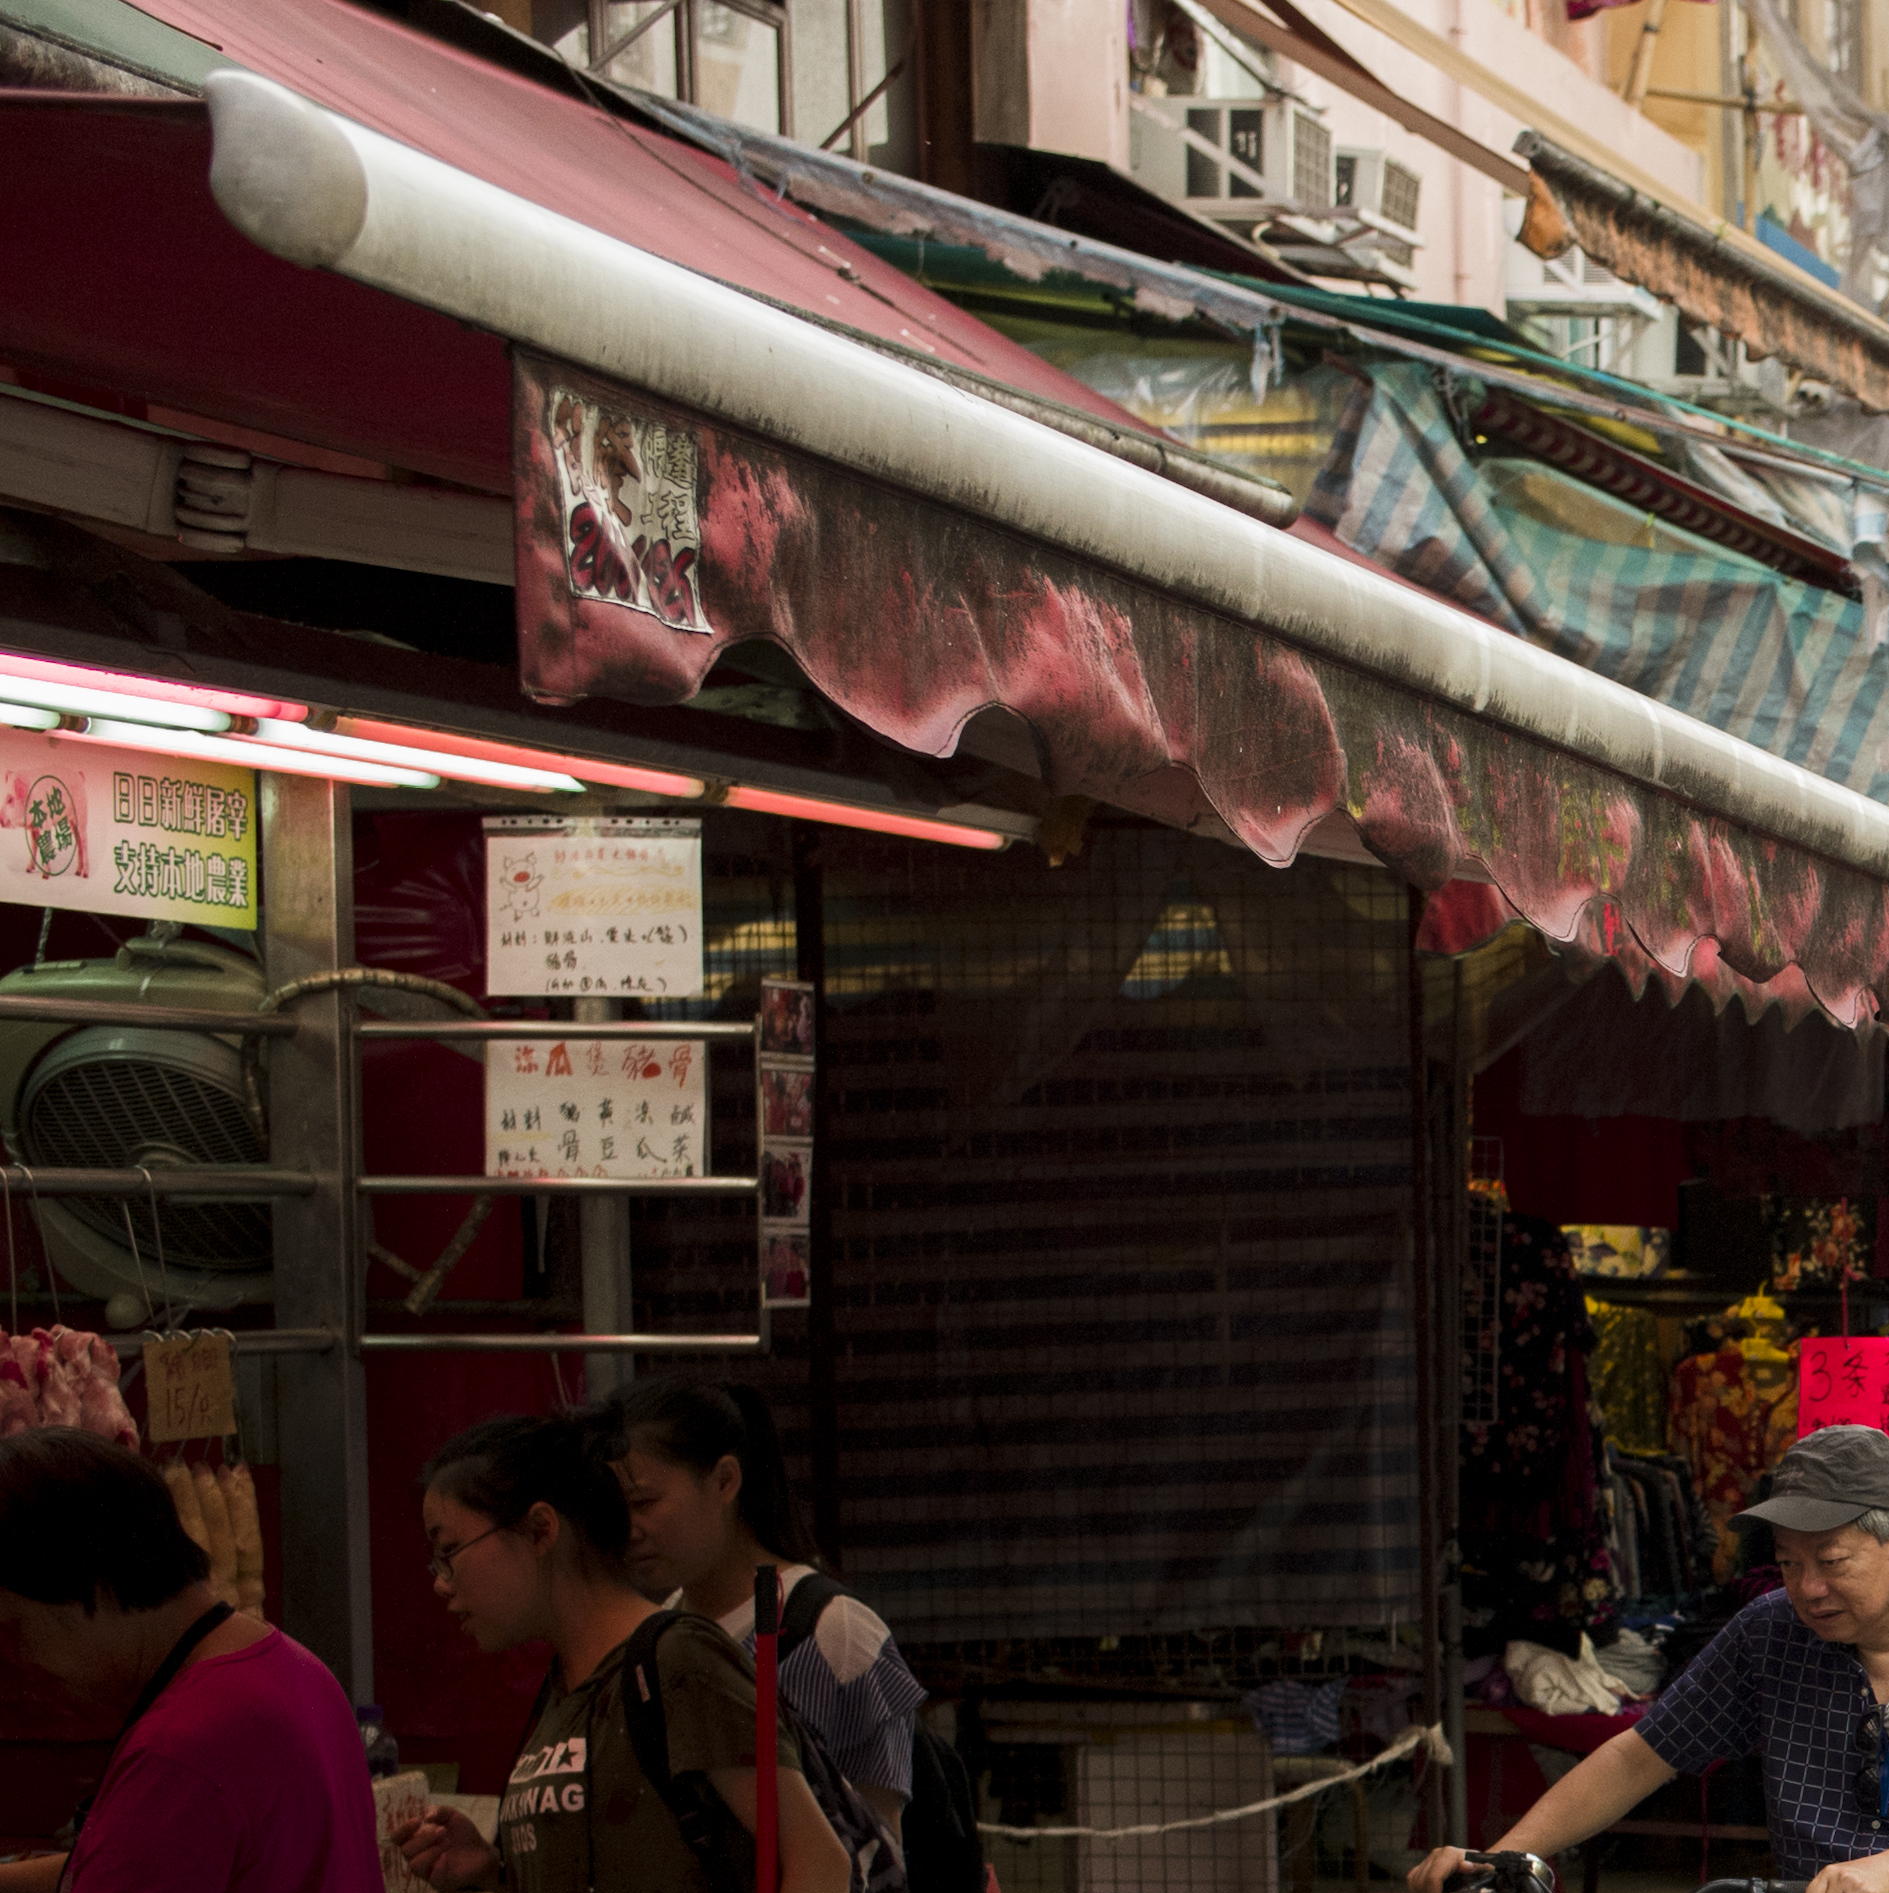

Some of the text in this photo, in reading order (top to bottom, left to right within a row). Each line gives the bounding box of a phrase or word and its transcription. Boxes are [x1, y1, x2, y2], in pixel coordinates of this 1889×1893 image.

[112, 771, 248, 841] 日日新鮮屠宰
[112, 839, 249, 908] 支持本地農業
